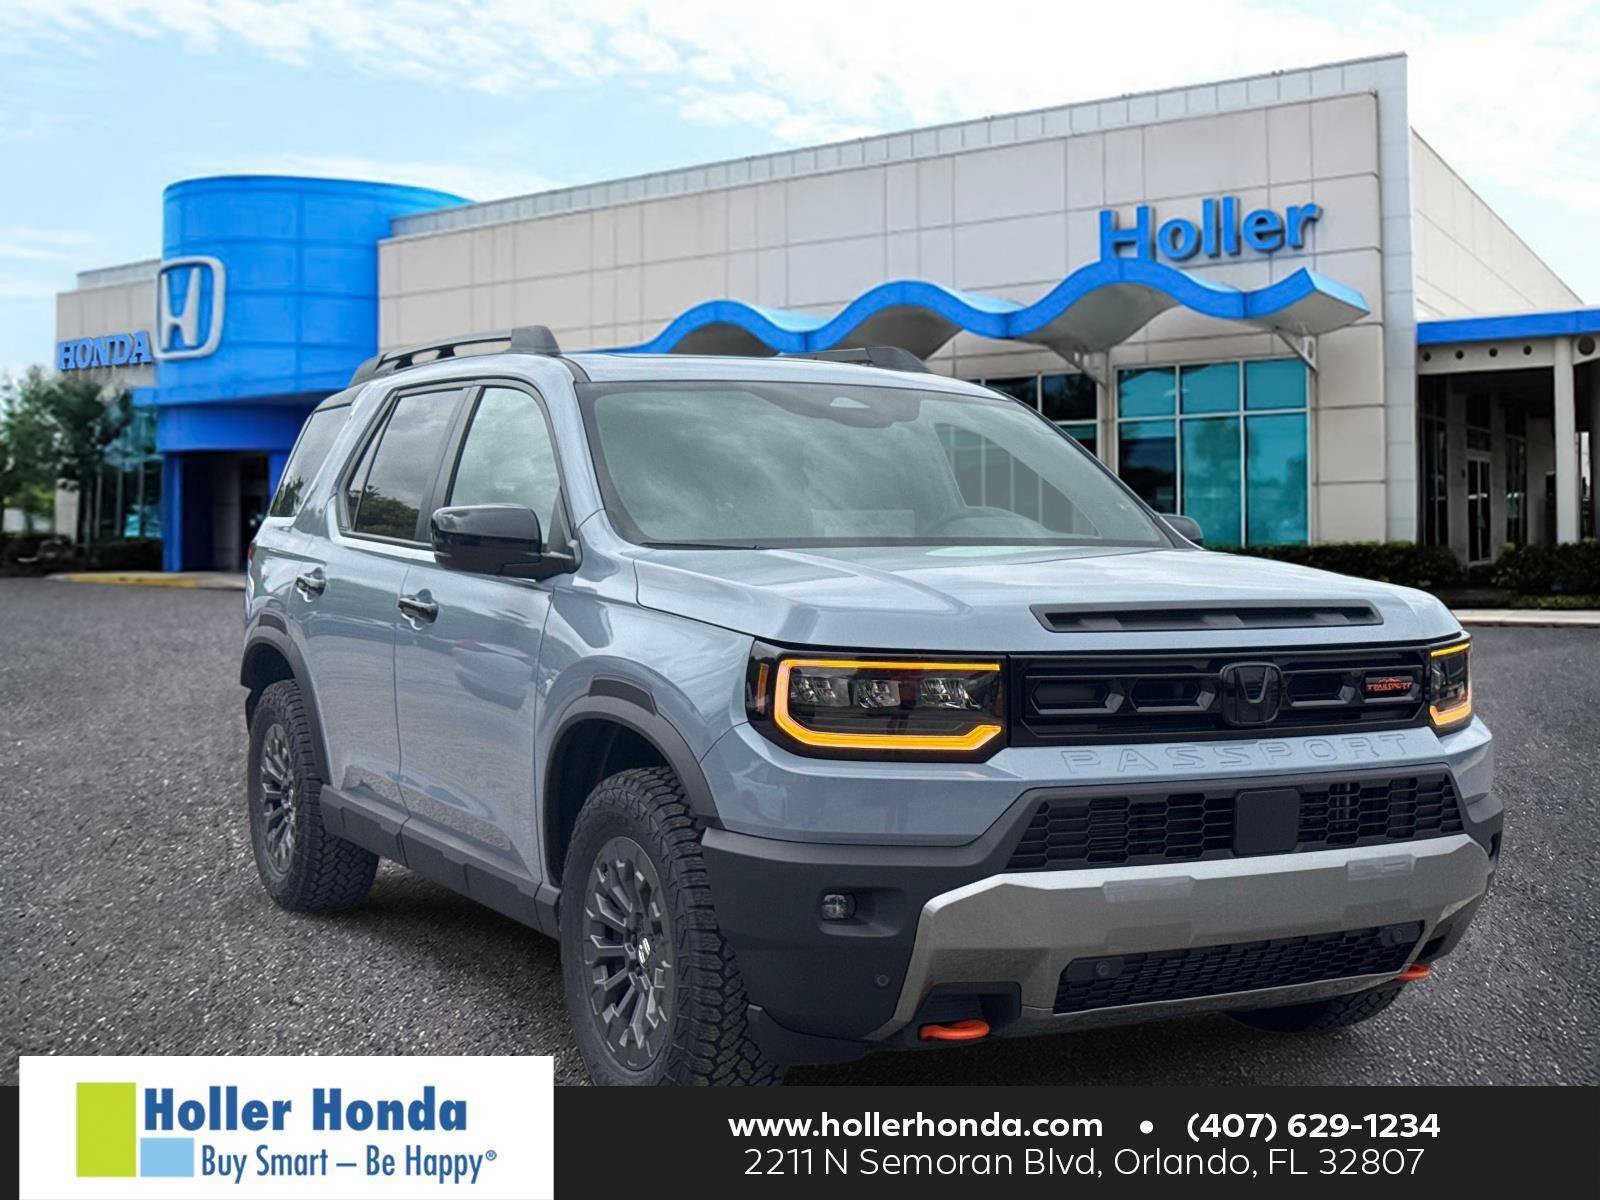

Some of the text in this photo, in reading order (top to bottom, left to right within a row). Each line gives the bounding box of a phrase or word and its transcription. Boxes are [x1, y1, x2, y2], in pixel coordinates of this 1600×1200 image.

[1099, 195, 1323, 262] Holler
[57, 330, 153, 370] HONDA
[1060, 733, 1407, 775] PASSPORT
